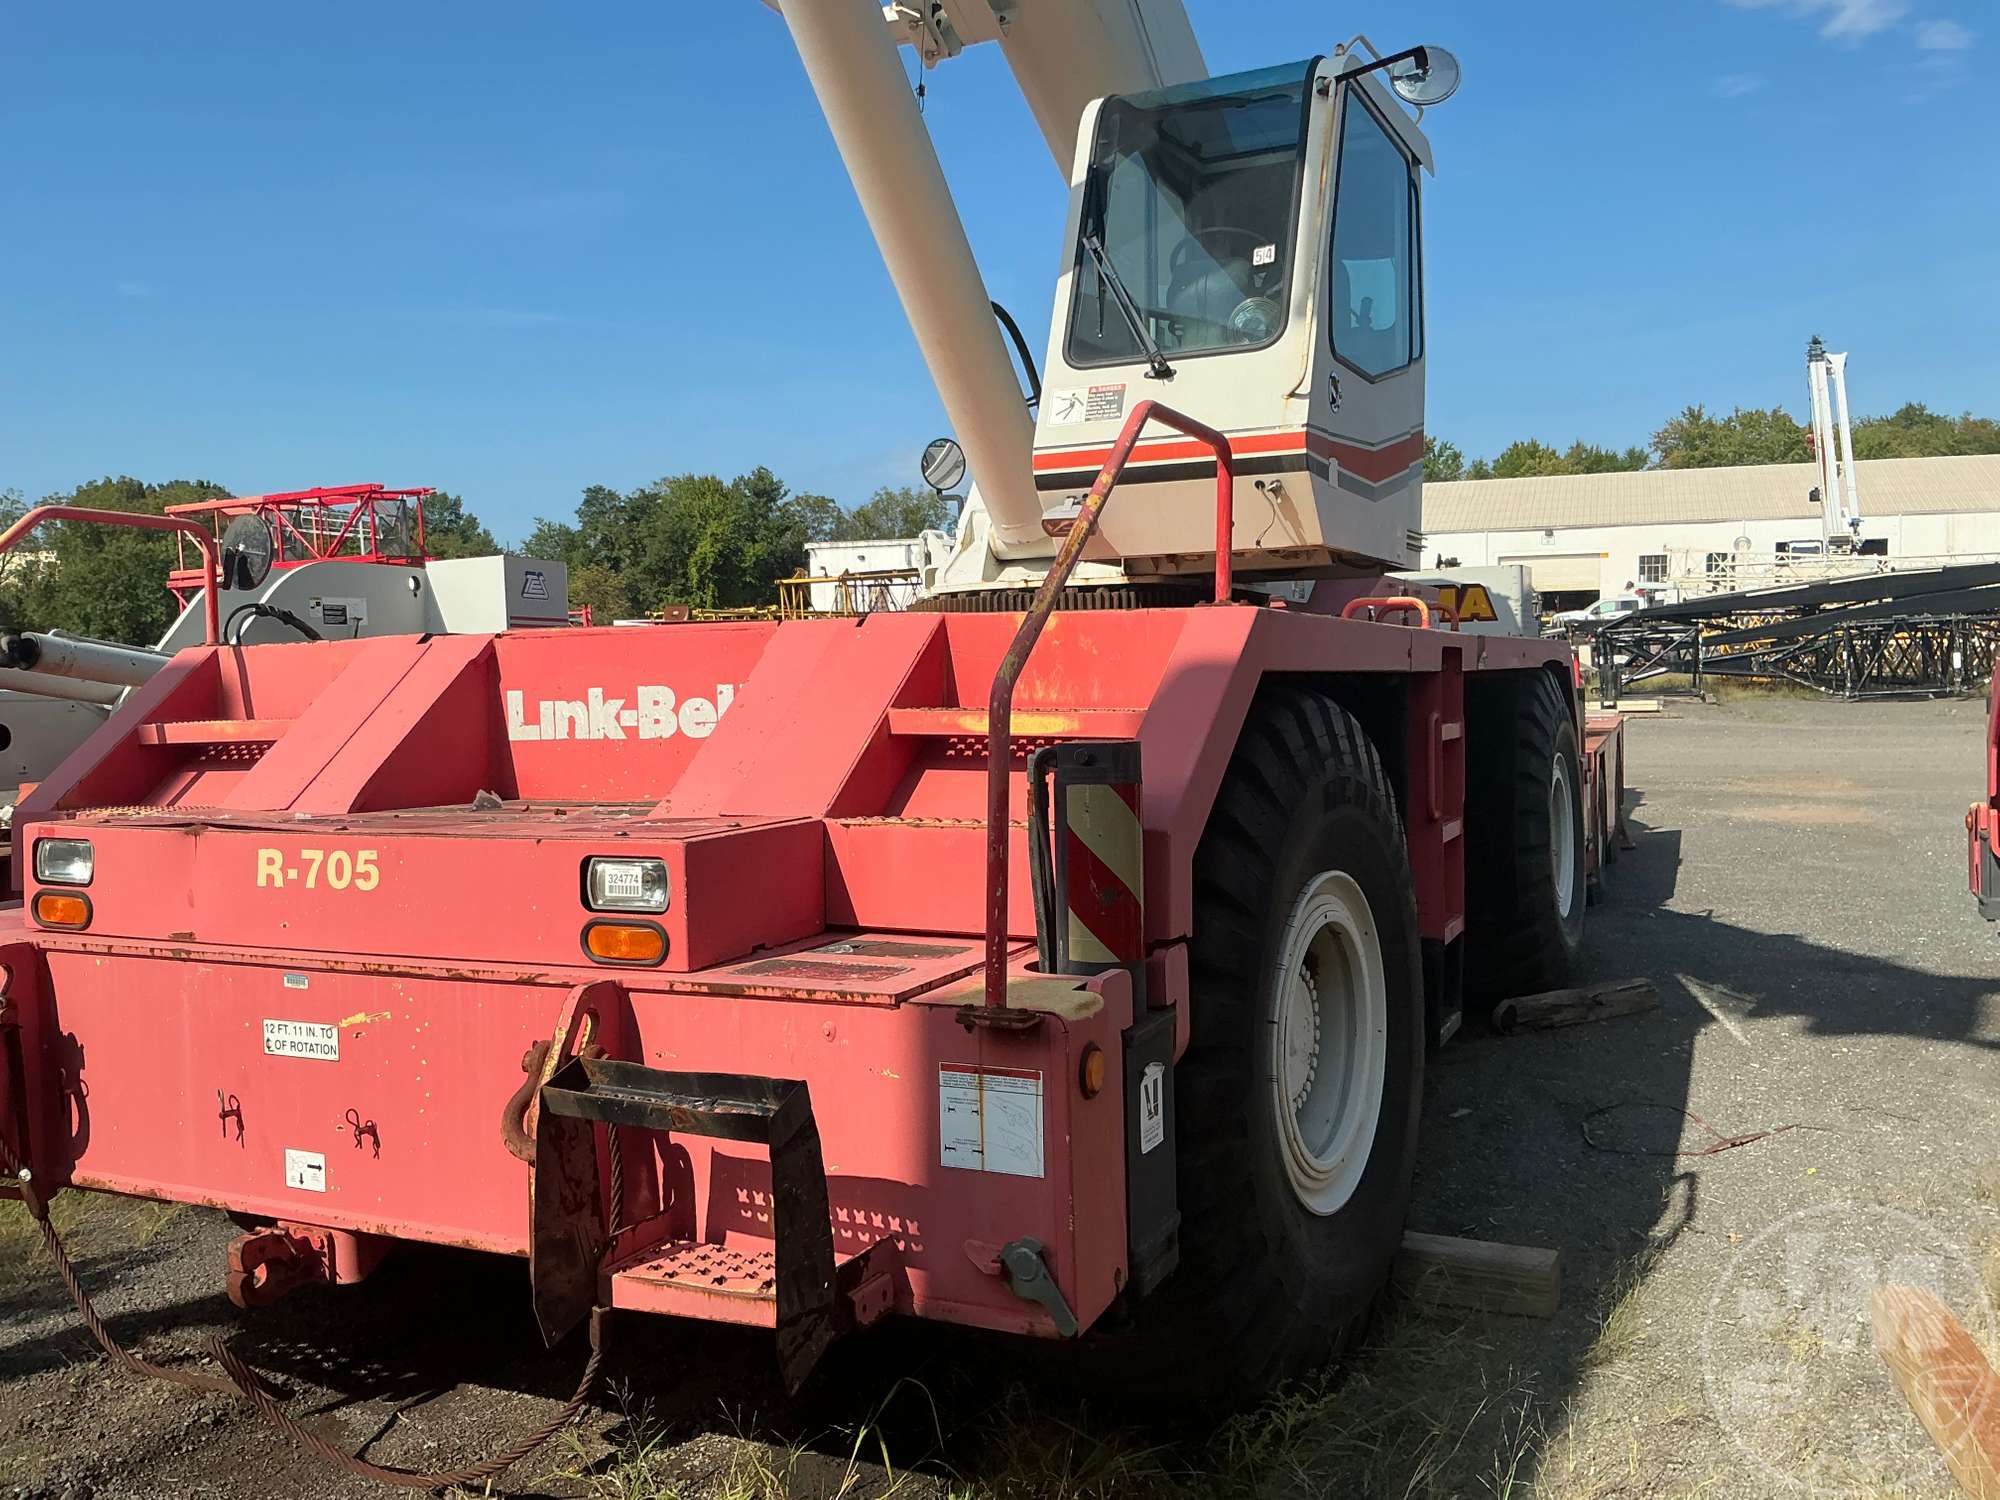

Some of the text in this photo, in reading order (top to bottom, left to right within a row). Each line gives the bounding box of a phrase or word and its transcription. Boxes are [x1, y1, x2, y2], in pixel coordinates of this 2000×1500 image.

[256, 848, 380, 891] R-705
[608, 874, 639, 884] 324774
[265, 1023, 333, 1039] 12 FT. 11 IN. TO
[275, 1039, 287, 1051] OF
[290, 1040, 337, 1056] ROTATION
